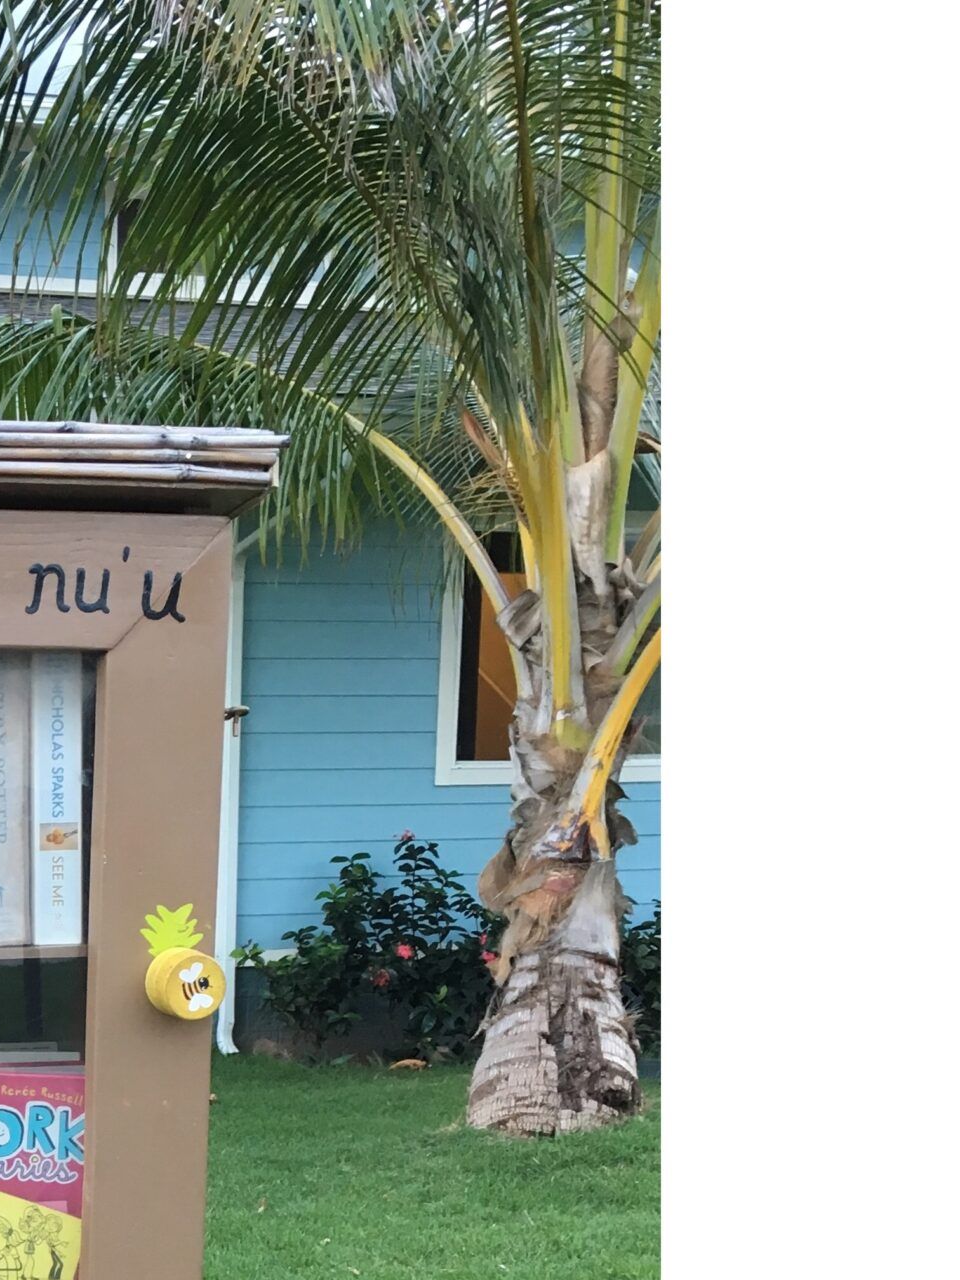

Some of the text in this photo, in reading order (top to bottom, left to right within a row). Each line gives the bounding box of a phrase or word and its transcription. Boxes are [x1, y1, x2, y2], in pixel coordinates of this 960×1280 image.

[51, 767, 65, 818] SPARKS
[51, 856, 65, 907] SEE ME
[1, 1084, 36, 1097] Renée
[41, 1086, 84, 1107] Russell
